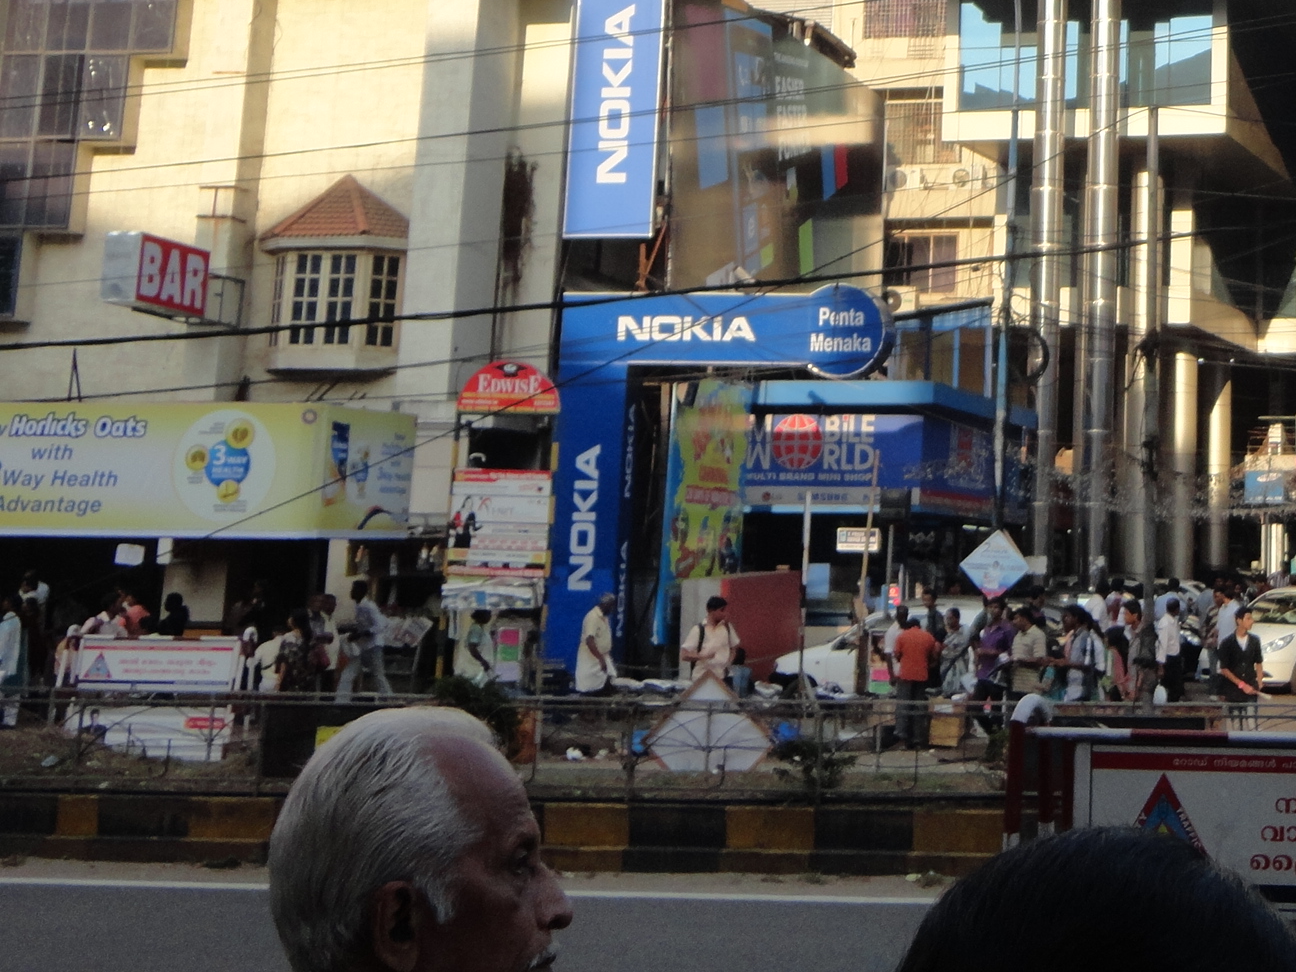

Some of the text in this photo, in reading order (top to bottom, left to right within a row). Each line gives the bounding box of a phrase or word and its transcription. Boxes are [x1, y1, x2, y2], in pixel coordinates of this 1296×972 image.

[596, 3, 636, 184] NOKIA
[139, 241, 206, 310] BAR
[617, 315, 756, 342] NOKIA
[818, 306, 865, 327] Penta
[809, 333, 872, 353] Menaka
[9, 412, 88, 439] Horlicks
[94, 415, 149, 438] Oats
[31, 443, 74, 460] with
[51, 469, 119, 488] Health
[567, 444, 601, 591] NOKIA
